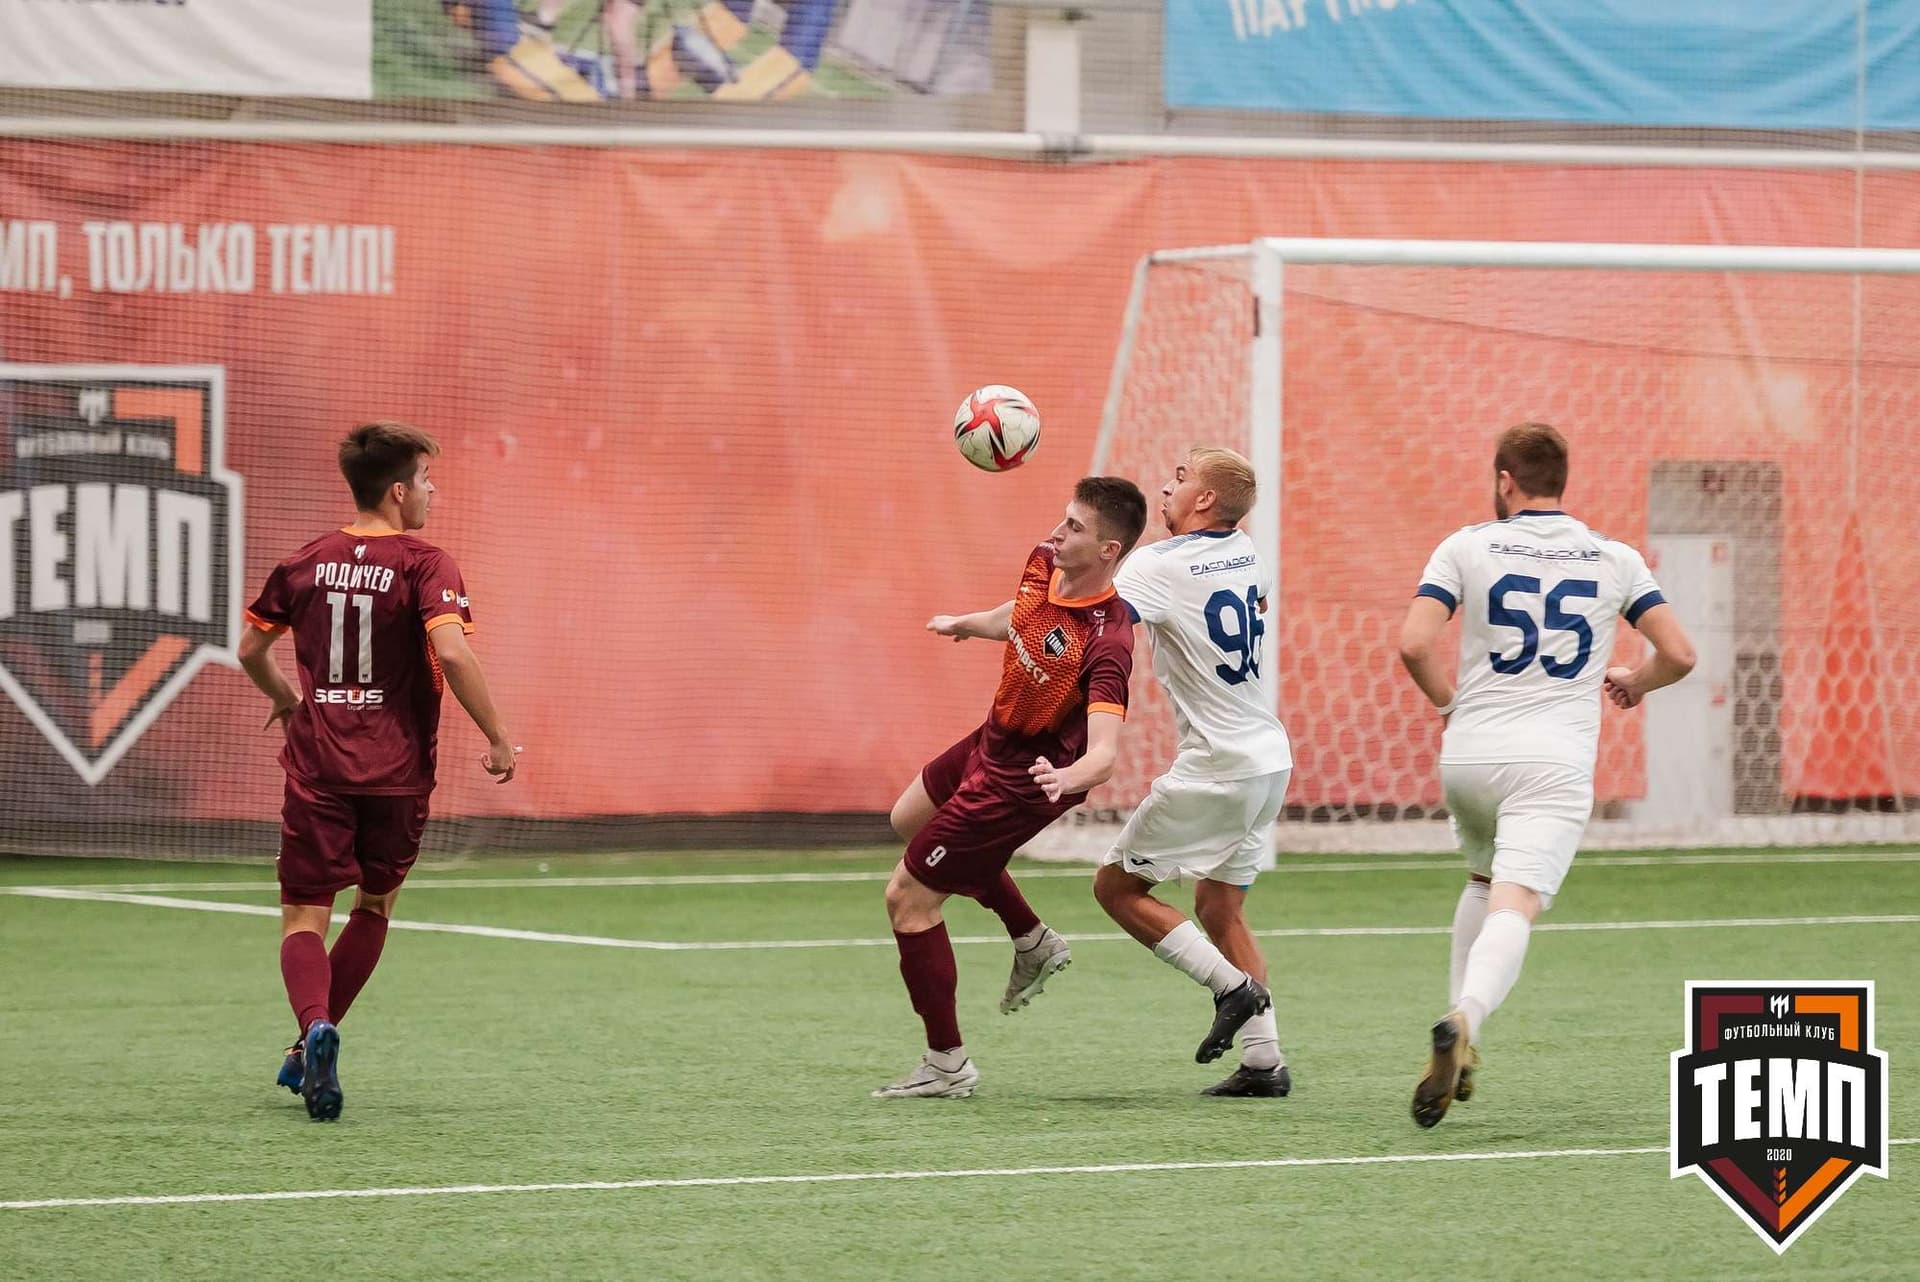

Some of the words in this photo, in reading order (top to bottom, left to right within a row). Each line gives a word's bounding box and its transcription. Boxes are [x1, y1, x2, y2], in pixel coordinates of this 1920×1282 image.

[82, 221, 256, 293] ТОЛЬКО
[267, 224, 395, 295] ТЕМП!
[315, 562, 395, 593] РОДИЧЕВ
[326, 591, 374, 684] 11
[1488, 573, 1598, 679] 55
[314, 688, 384, 704] SEUS
[925, 845, 947, 867] 9
